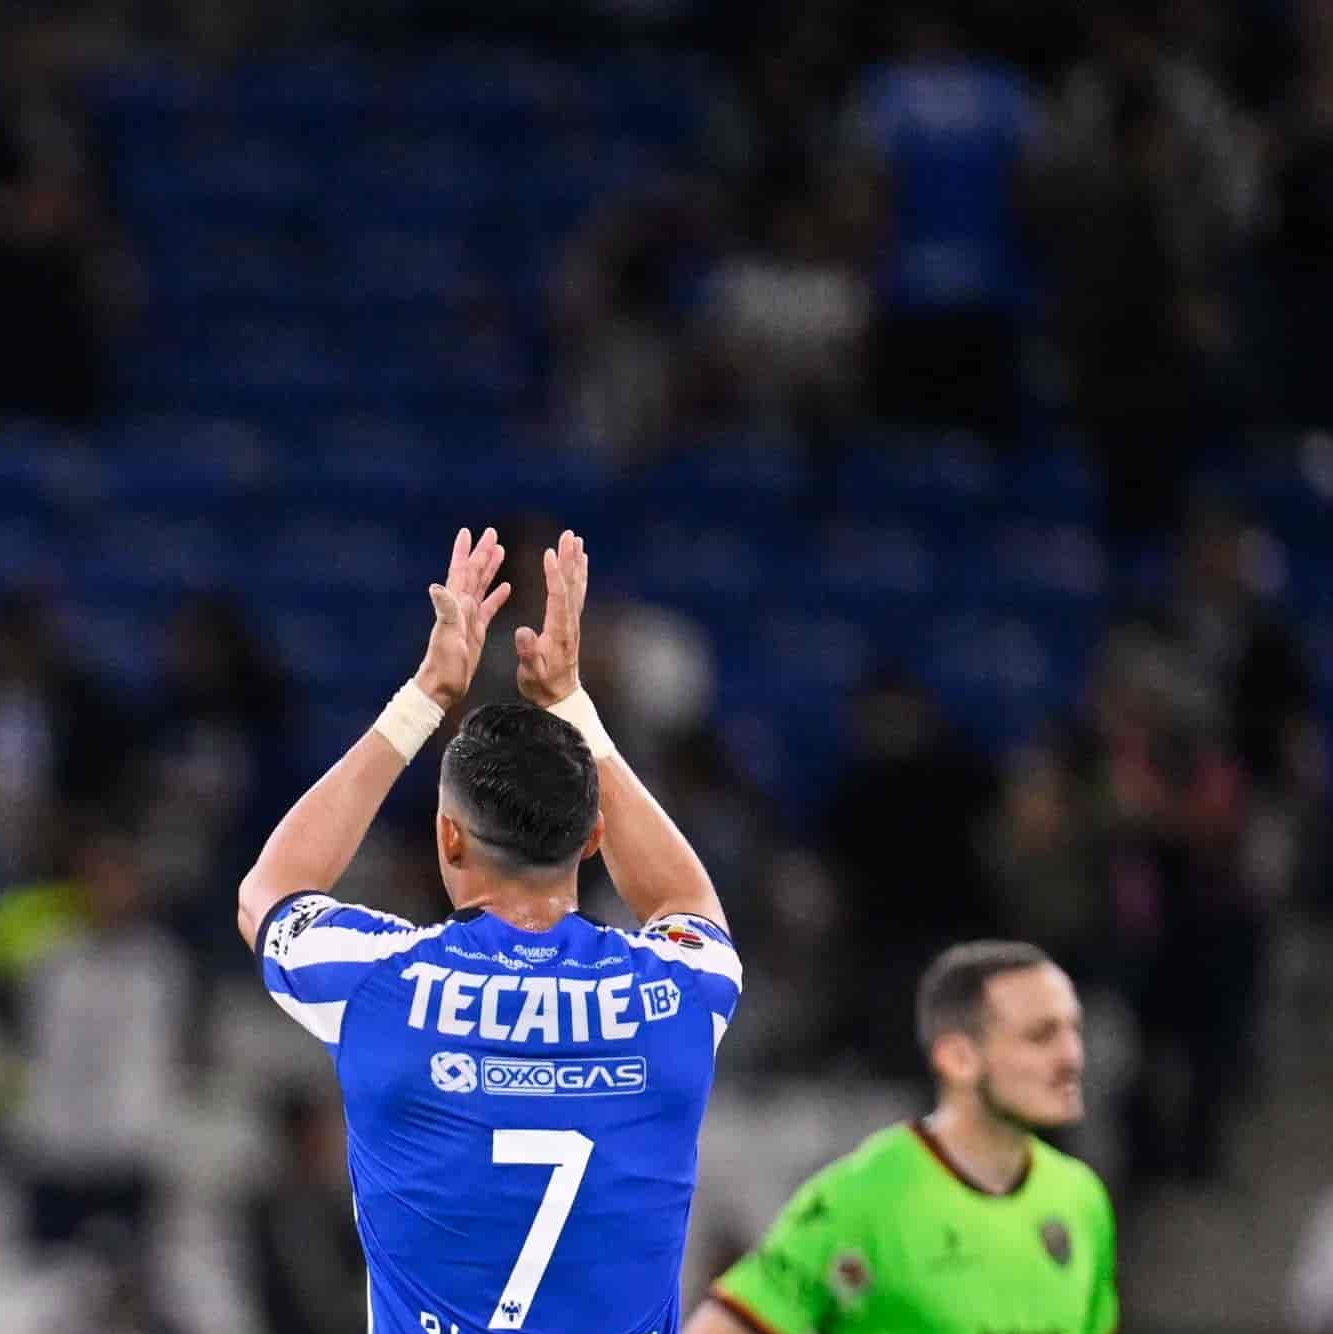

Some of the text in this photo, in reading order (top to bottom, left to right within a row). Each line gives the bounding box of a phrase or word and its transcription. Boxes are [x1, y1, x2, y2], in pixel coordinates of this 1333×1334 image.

[400, 961, 678, 1044] TECATE 18+
[486, 1129, 594, 1331] 7
